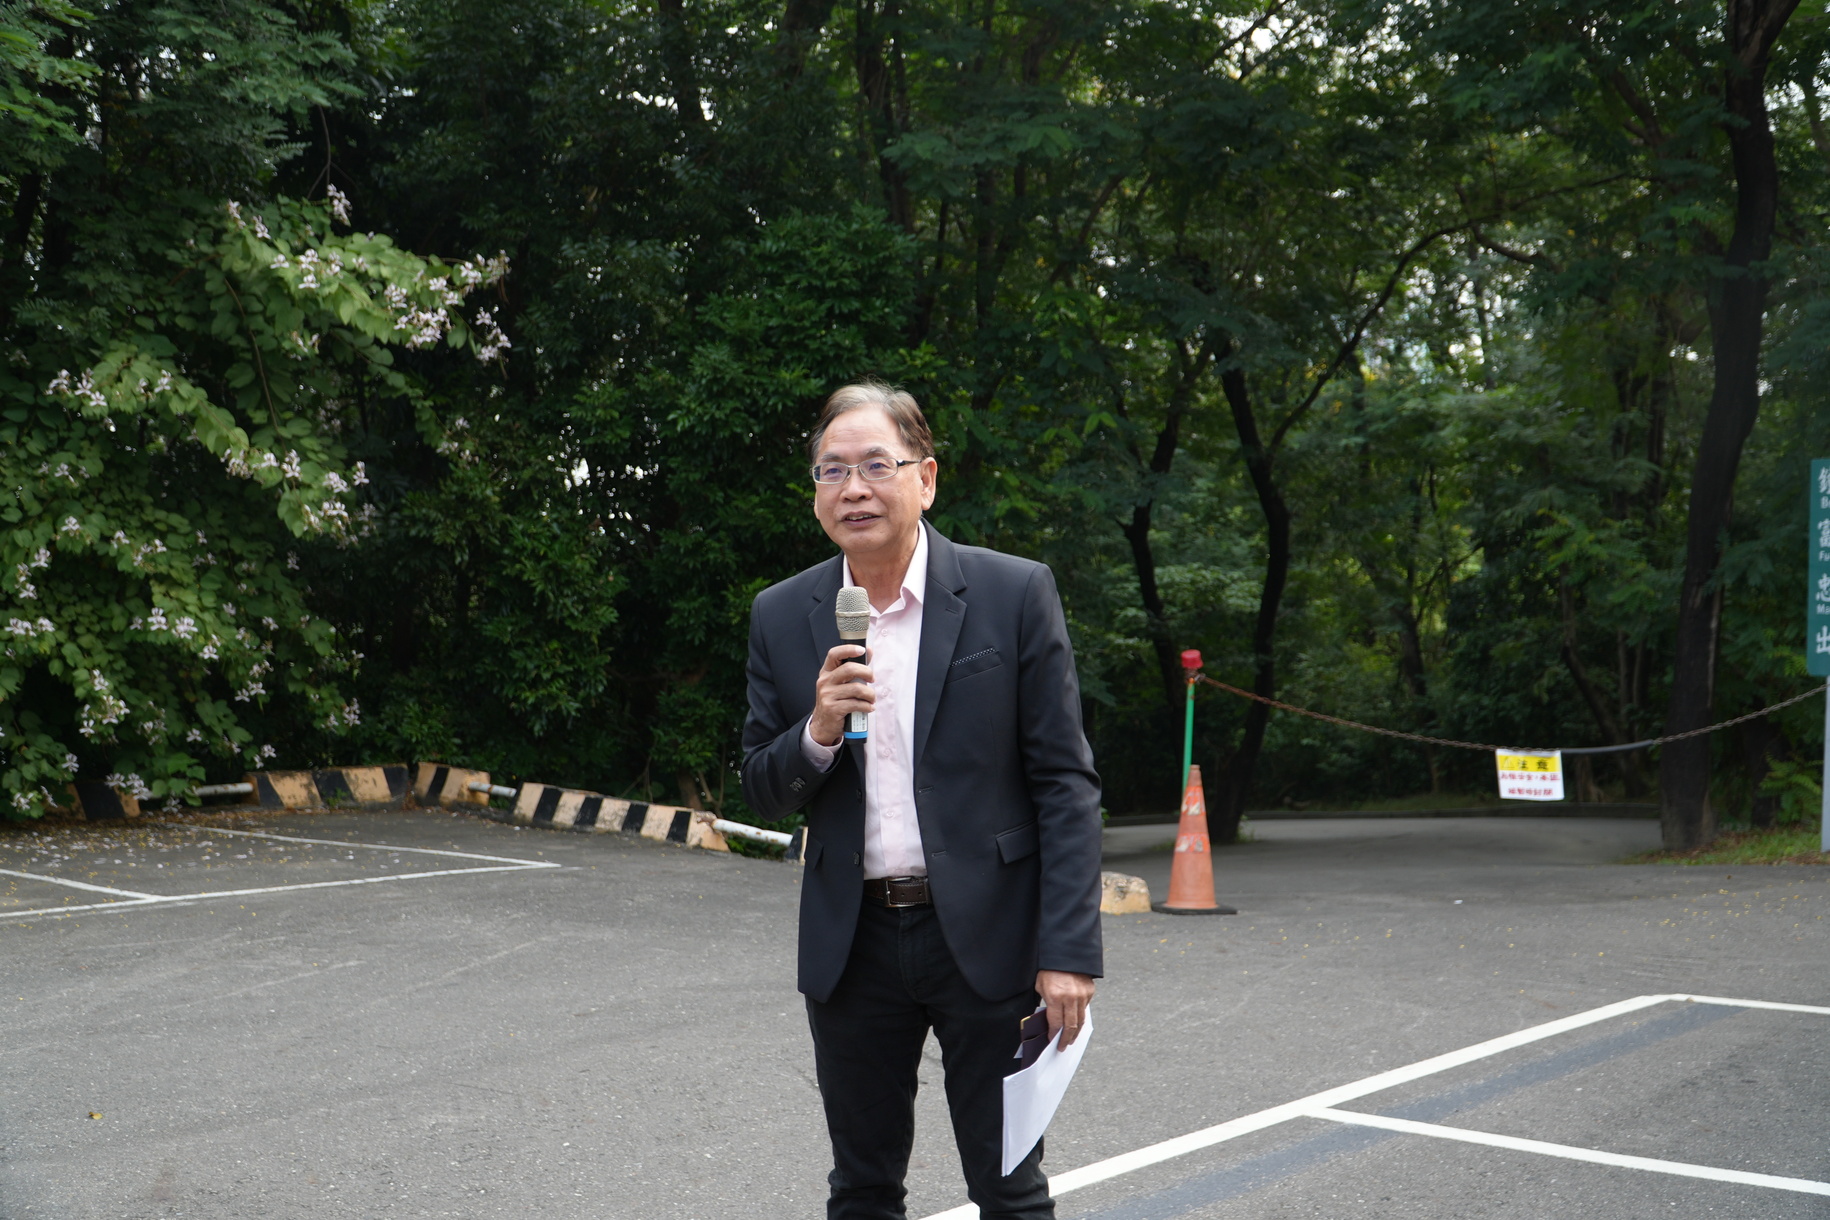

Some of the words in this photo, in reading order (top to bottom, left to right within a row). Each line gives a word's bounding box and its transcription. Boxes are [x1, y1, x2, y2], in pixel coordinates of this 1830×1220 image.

[1815, 573, 1830, 602] 忠
[1815, 625, 1830, 654] 出
[1517, 758, 1548, 770] 注意
